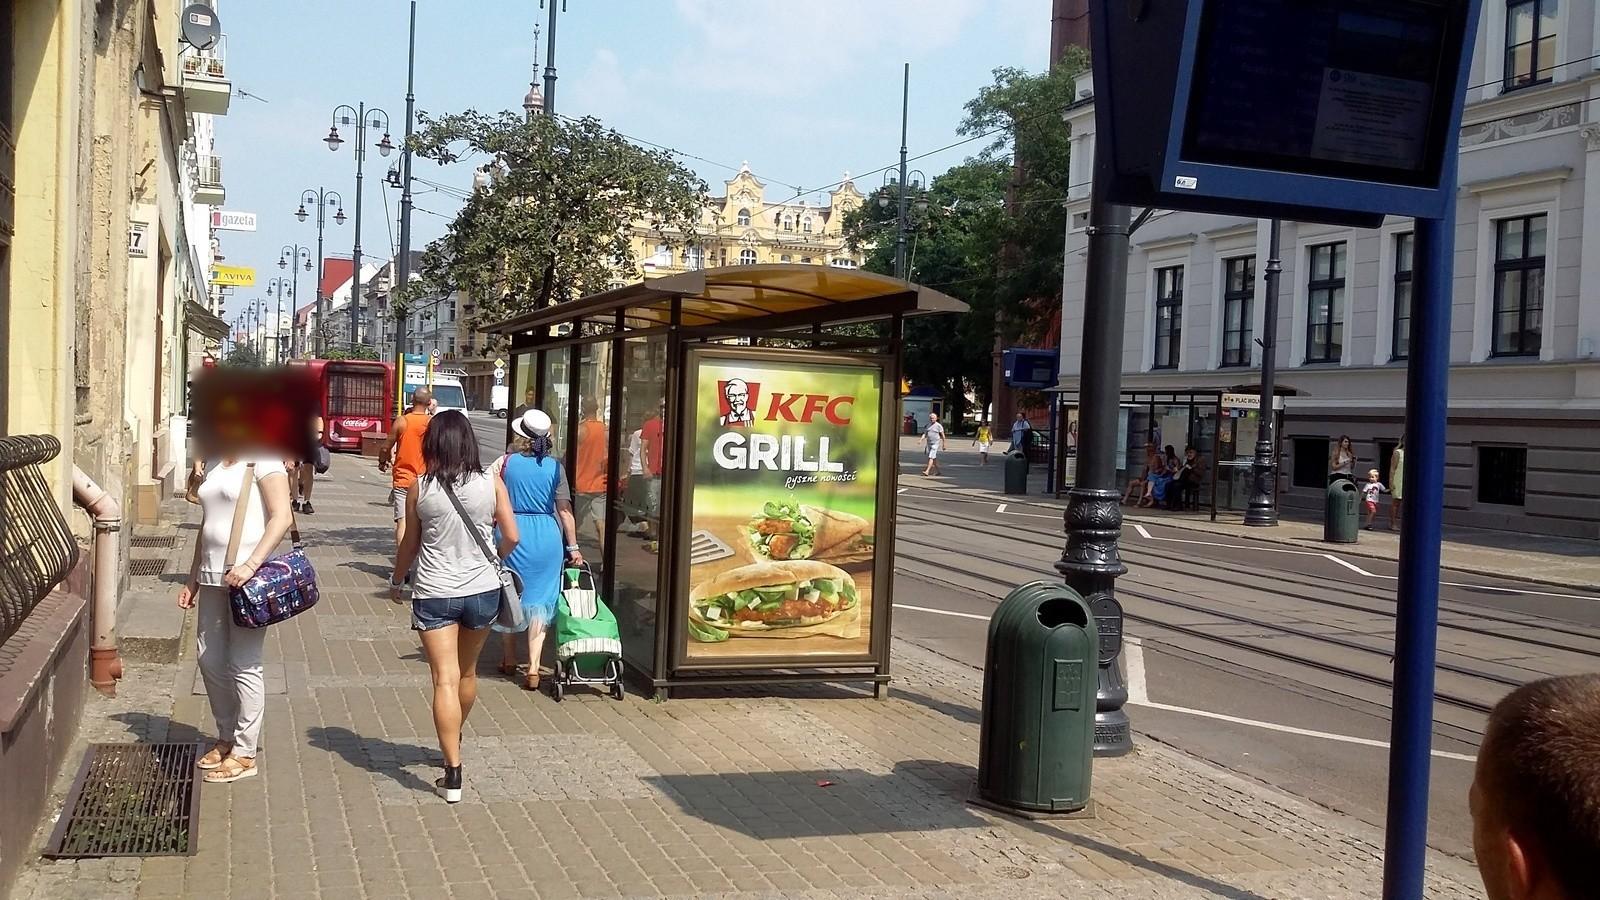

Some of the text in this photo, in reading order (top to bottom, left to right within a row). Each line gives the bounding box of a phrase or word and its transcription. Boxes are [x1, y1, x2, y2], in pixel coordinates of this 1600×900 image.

[222, 215, 255, 227] gazeta
[223, 273, 252, 281] AVIVA
[763, 393, 855, 425] KFC
[713, 432, 843, 472] GRILL
[784, 471, 857, 489] pyszne nowości
